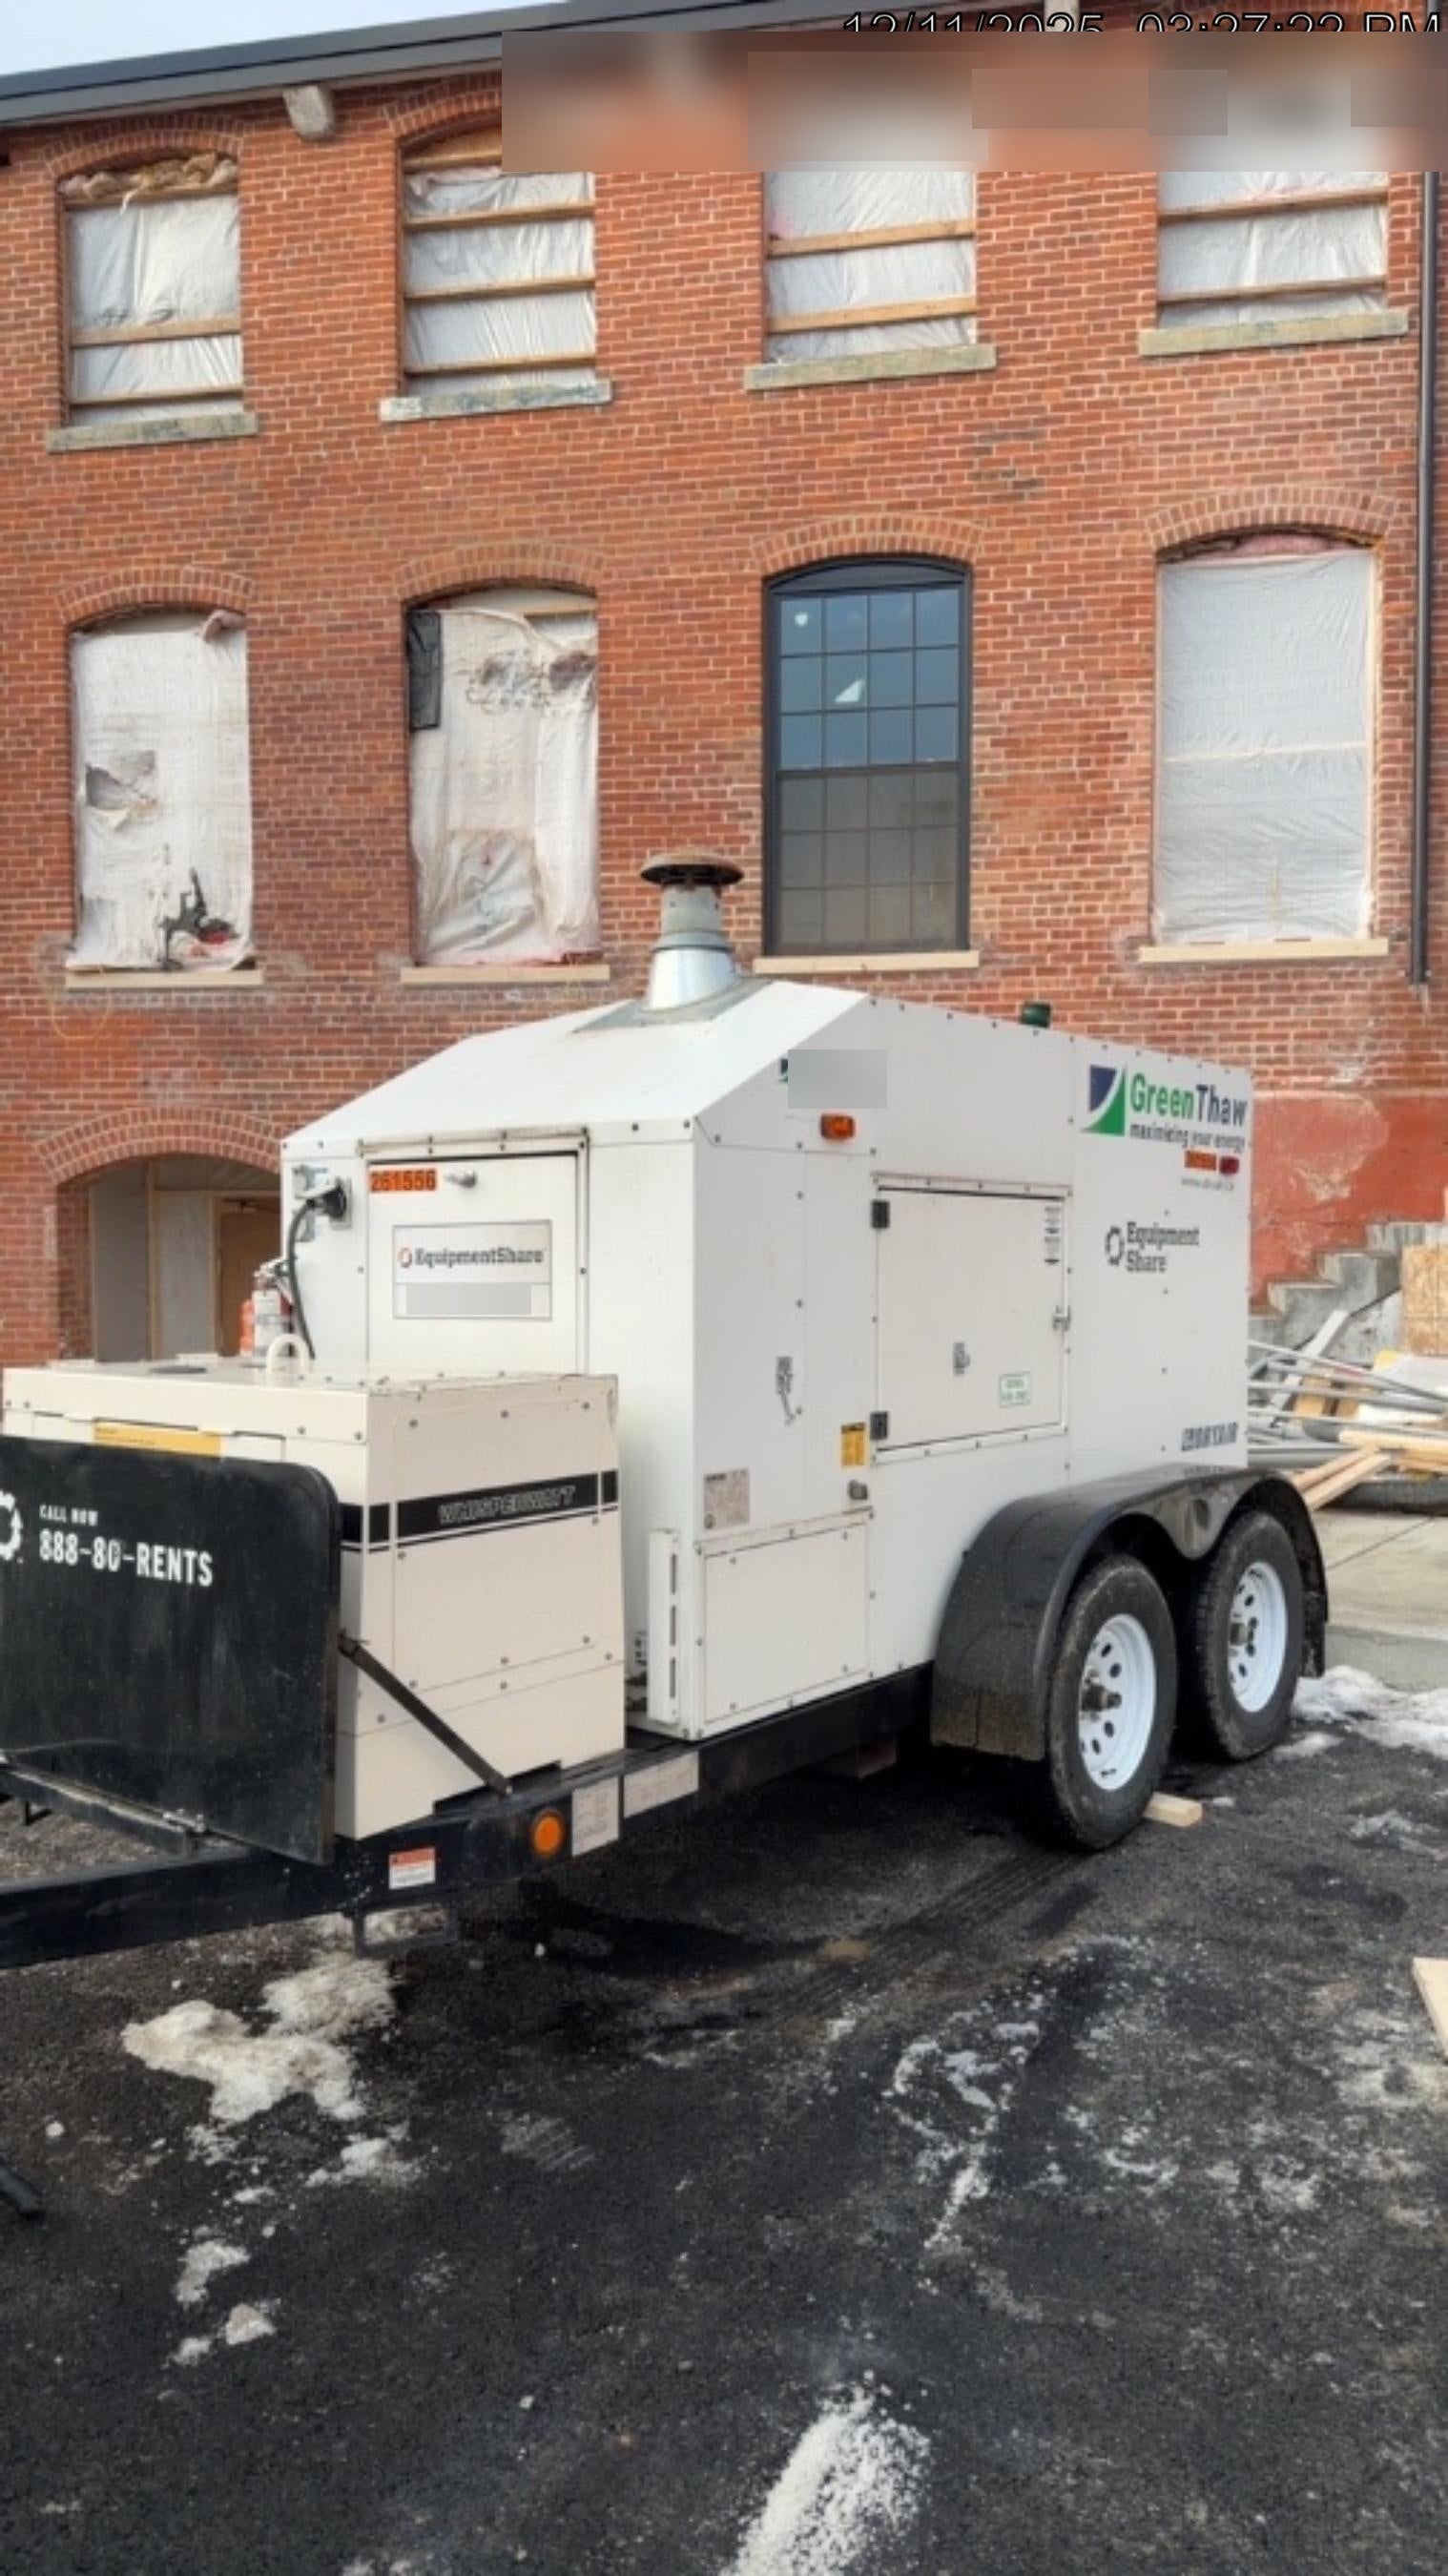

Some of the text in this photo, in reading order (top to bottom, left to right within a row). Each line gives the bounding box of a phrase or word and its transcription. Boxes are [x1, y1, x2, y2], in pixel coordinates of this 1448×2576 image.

[1130, 1072, 1248, 1126] GreenThaw
[1127, 1221, 1200, 1251] Equipment
[414, 1246, 545, 1269] EquipmentShare
[1127, 1250, 1167, 1273] Share
[39, 1504, 99, 1527] CALL NOW
[39, 1528, 214, 1588] 888-80-RENTS
